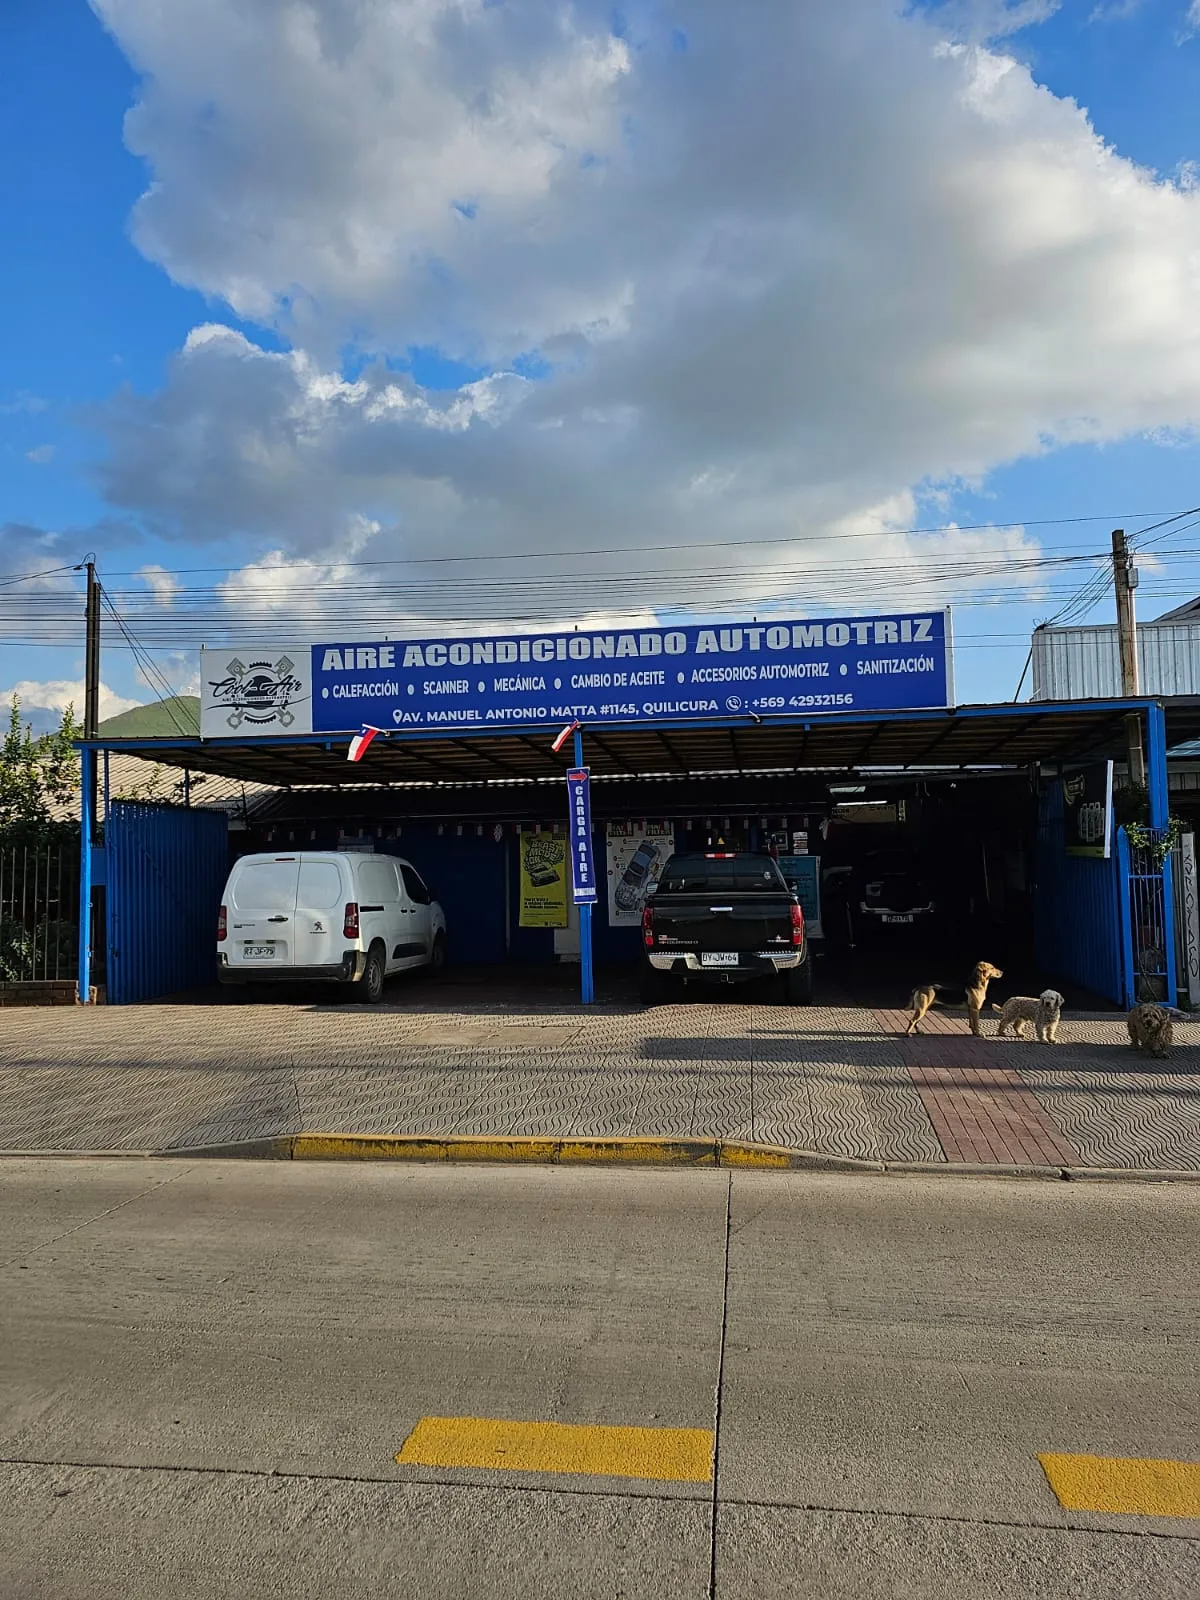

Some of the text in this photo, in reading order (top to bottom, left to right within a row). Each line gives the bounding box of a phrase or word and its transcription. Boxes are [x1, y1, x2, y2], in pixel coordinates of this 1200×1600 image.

[322, 618, 933, 671] AIRE ACONDICIONADO AUTOMOTRIZ
[691, 663, 830, 683] ACCESORIOS AUTOMOTRIZ
[856, 655, 934, 675] SANITIZACIÓN
[208, 674, 303, 698] Cool Air
[332, 680, 399, 698] CALEFACCIÓN
[423, 680, 469, 695] SCANNER
[494, 674, 546, 692] MECÁNICA
[571, 670, 665, 688] CAMBIO DE ACEITE
[402, 712, 424, 723] AV.
[426, 710, 483, 722] MANUEL
[485, 707, 547, 720] ANTONIO
[550, 705, 597, 717] MATTA
[599, 703, 640, 715] #1145,
[642, 699, 719, 715] QUILICURA
[751, 696, 785, 708] +569
[788, 693, 854, 707] 42932156
[574, 785, 587, 837] CARGA
[578, 842, 589, 883] AIRE
